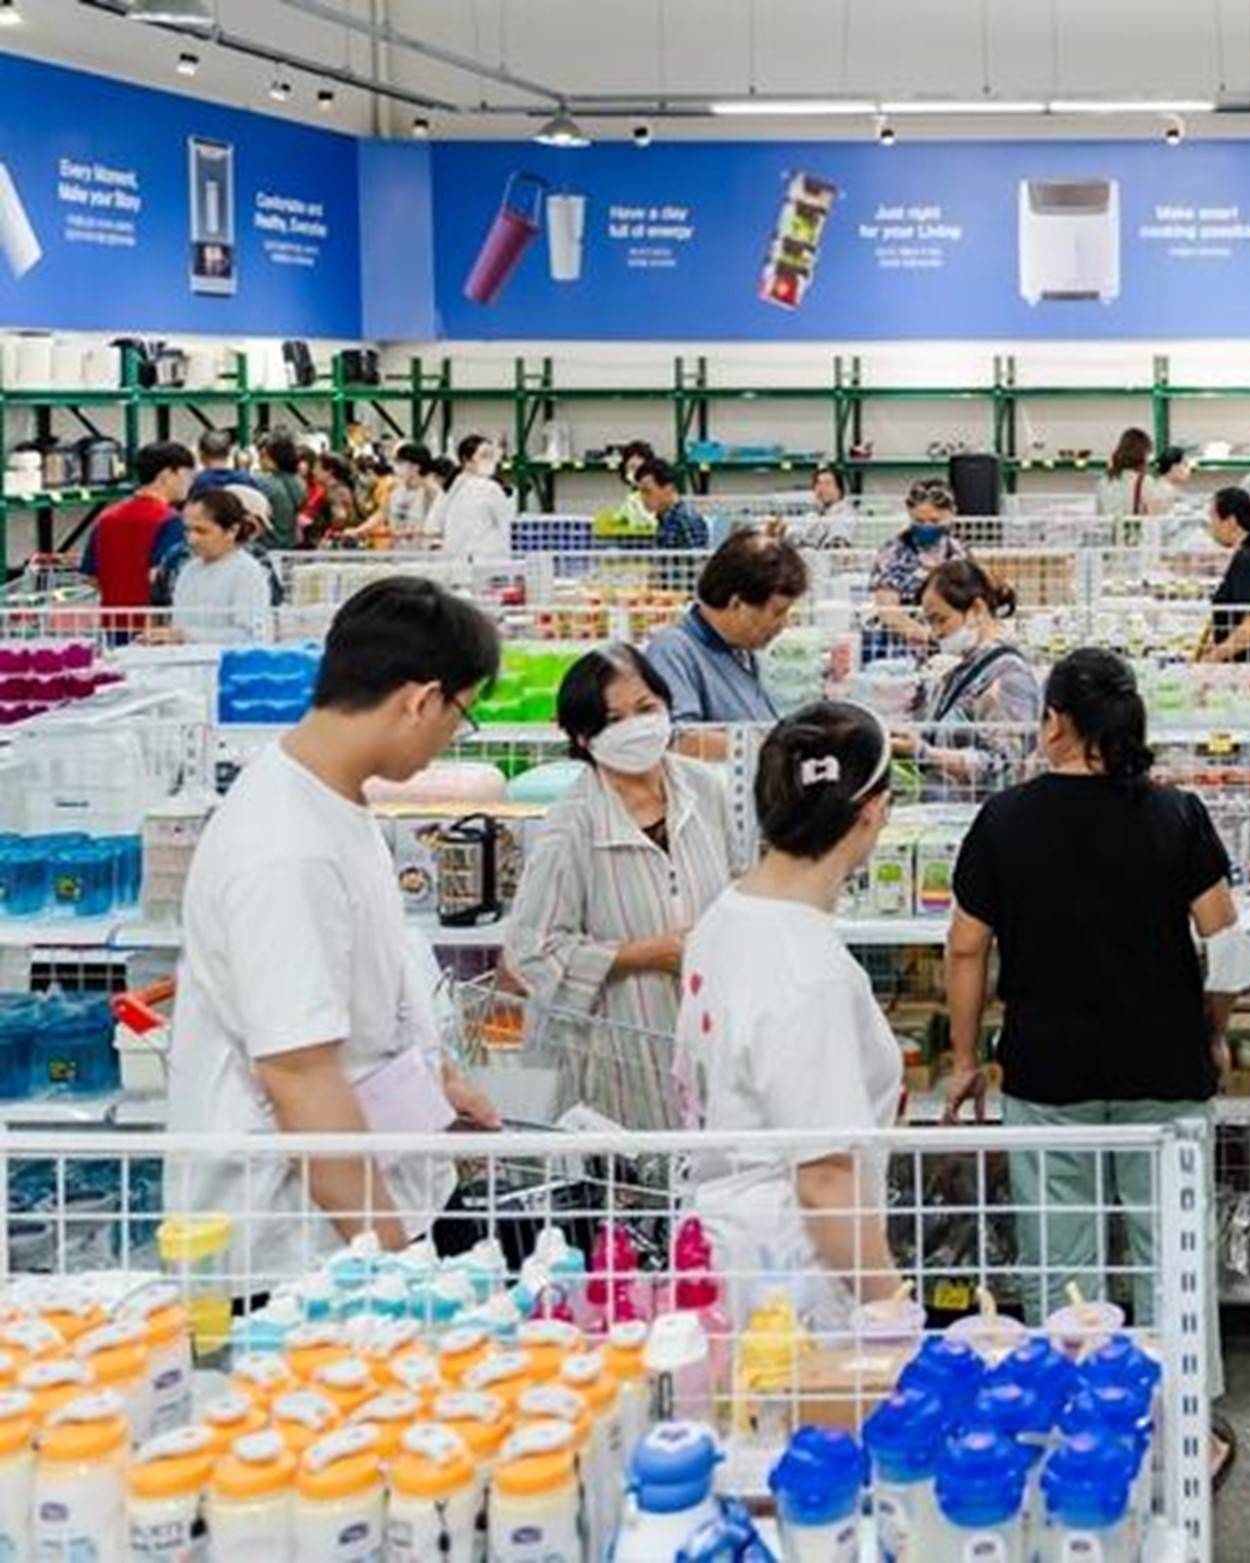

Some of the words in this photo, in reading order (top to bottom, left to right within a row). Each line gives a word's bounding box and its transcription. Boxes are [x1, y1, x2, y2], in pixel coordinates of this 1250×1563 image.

[59, 158, 91, 182] Every
[609, 205, 644, 220] Have
[661, 205, 688, 221] day
[874, 203, 904, 220] Just
[906, 204, 941, 221] right
[1155, 205, 1195, 220] Make
[1198, 204, 1239, 220] smart
[609, 224, 629, 238] full
[631, 224, 645, 238] of
[647, 226, 694, 242] energy
[859, 224, 879, 238] for
[880, 226, 914, 241] your
[917, 224, 962, 242] Living
[1139, 225, 1197, 241] cooking
